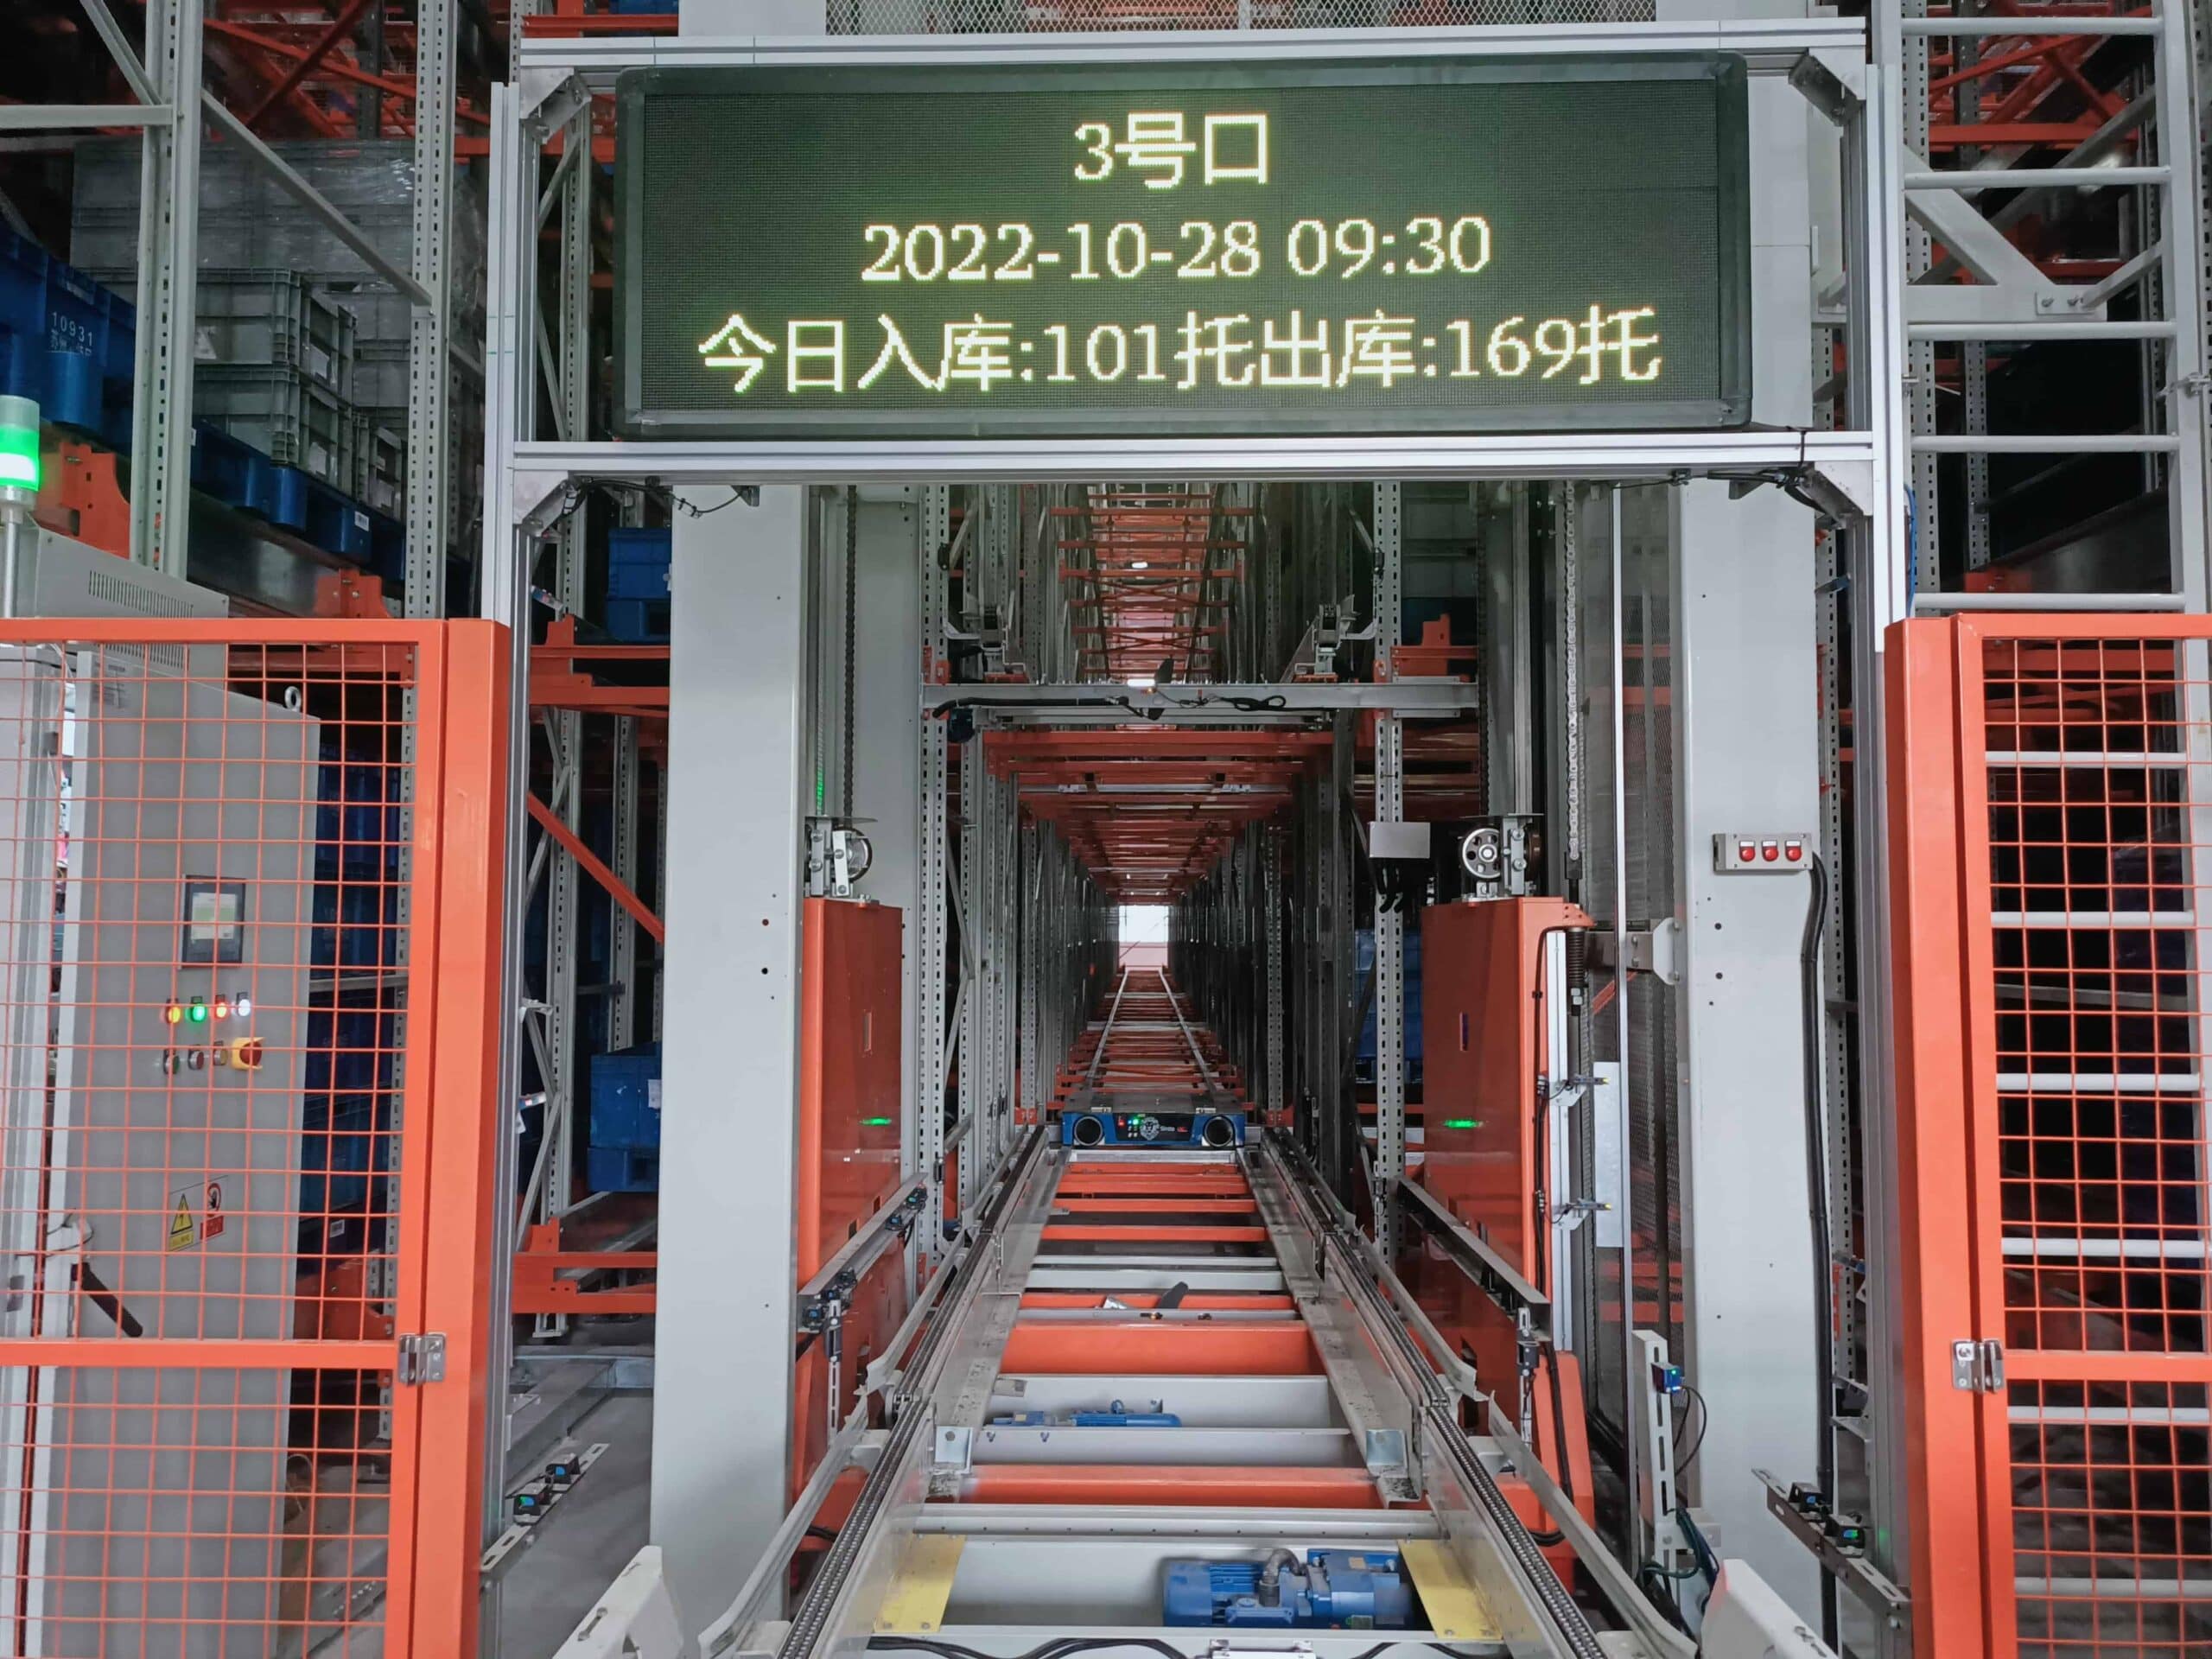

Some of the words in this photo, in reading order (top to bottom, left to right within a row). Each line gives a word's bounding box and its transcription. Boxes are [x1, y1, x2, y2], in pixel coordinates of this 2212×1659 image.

[1074, 111, 1268, 190] 3号口
[861, 220, 1261, 282] 2022-10-28
[1287, 216, 1491, 279] 09:30
[52, 311, 92, 346] 10931
[697, 305, 1662, 394] 今日入库:101托出库:169托
